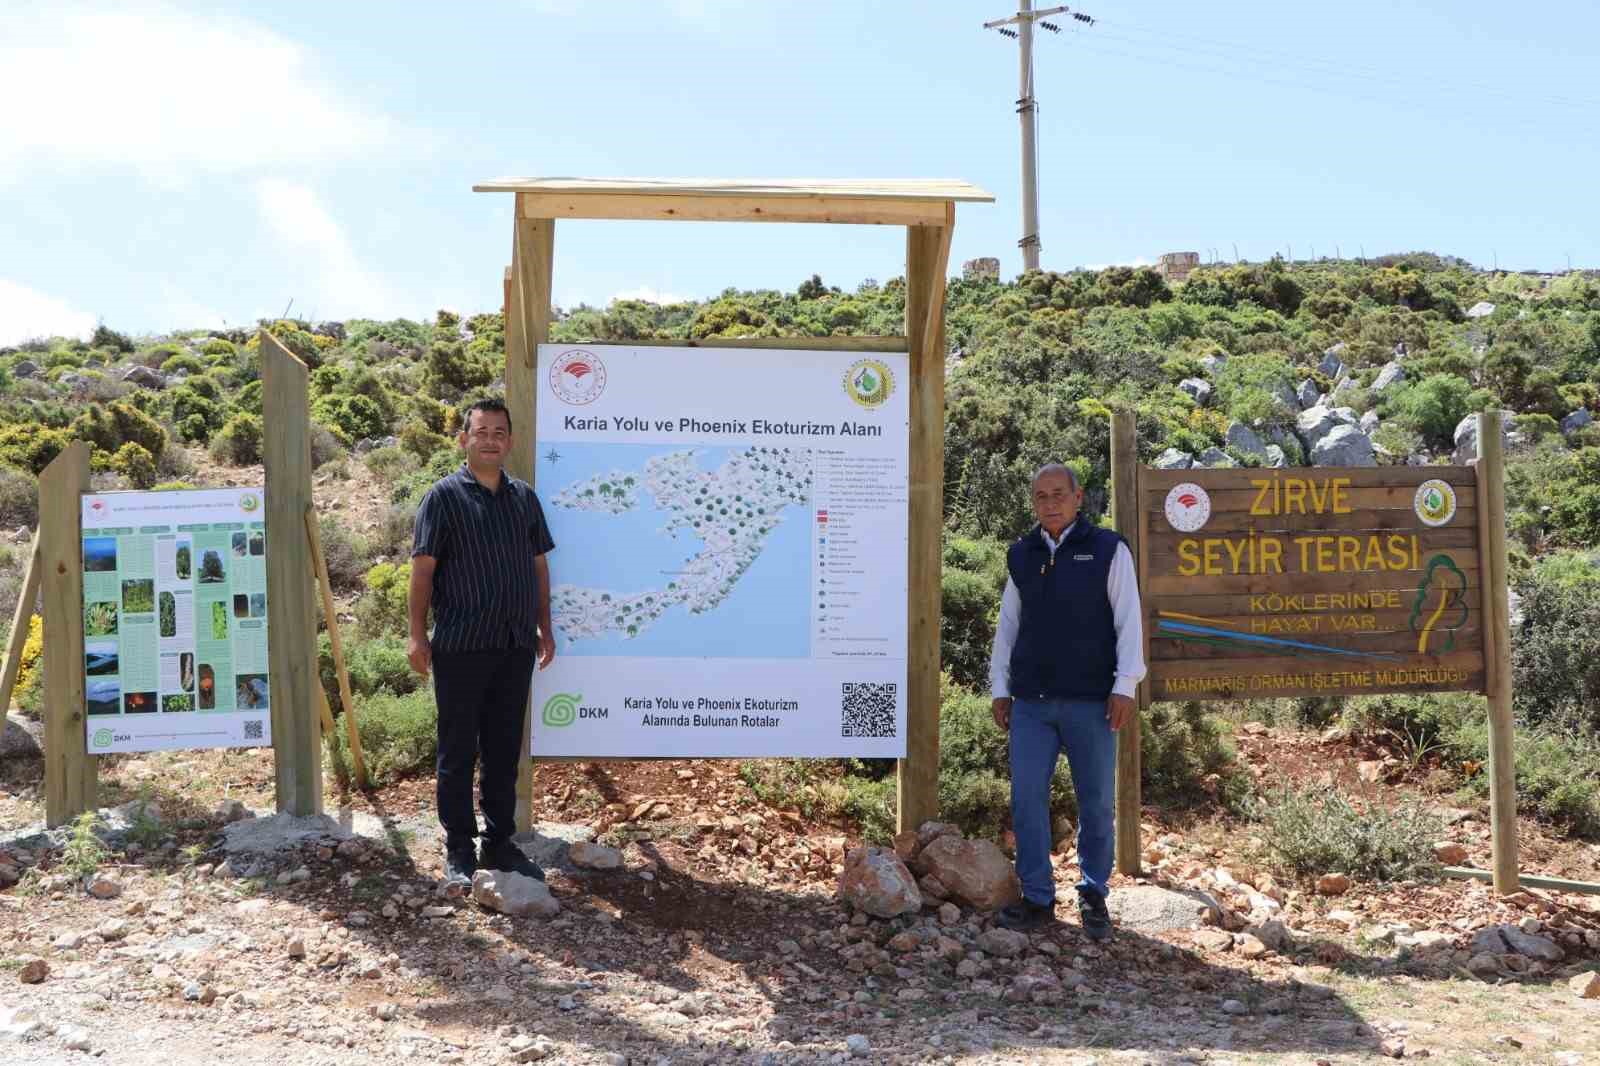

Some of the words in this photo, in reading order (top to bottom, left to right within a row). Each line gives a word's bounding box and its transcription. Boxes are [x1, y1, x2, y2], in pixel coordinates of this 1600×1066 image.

[564, 416, 608, 432] Karia
[613, 417, 649, 432] Yolu
[655, 420, 674, 432] ve
[679, 418, 747, 434] Phoenix
[752, 419, 835, 436] Ekoturizm
[840, 421, 882, 437] Alanı
[1249, 471, 1353, 516] ZİRVE
[1177, 527, 1284, 576] SEYİR
[1294, 534, 1421, 574] TERASI
[1249, 616, 1322, 634] HAYAT
[1250, 671, 1306, 691] ORMAN
[579, 707, 609, 719] DKM
[624, 697, 654, 710] Karia
[655, 697, 680, 710] Yolu
[681, 700, 696, 710] ve
[697, 698, 742, 711] Phoenix
[744, 698, 799, 711] Ekoturizm
[642, 714, 691, 727] Alanında
[693, 714, 739, 728] Bulunan
[741, 715, 781, 728] Rotalar
